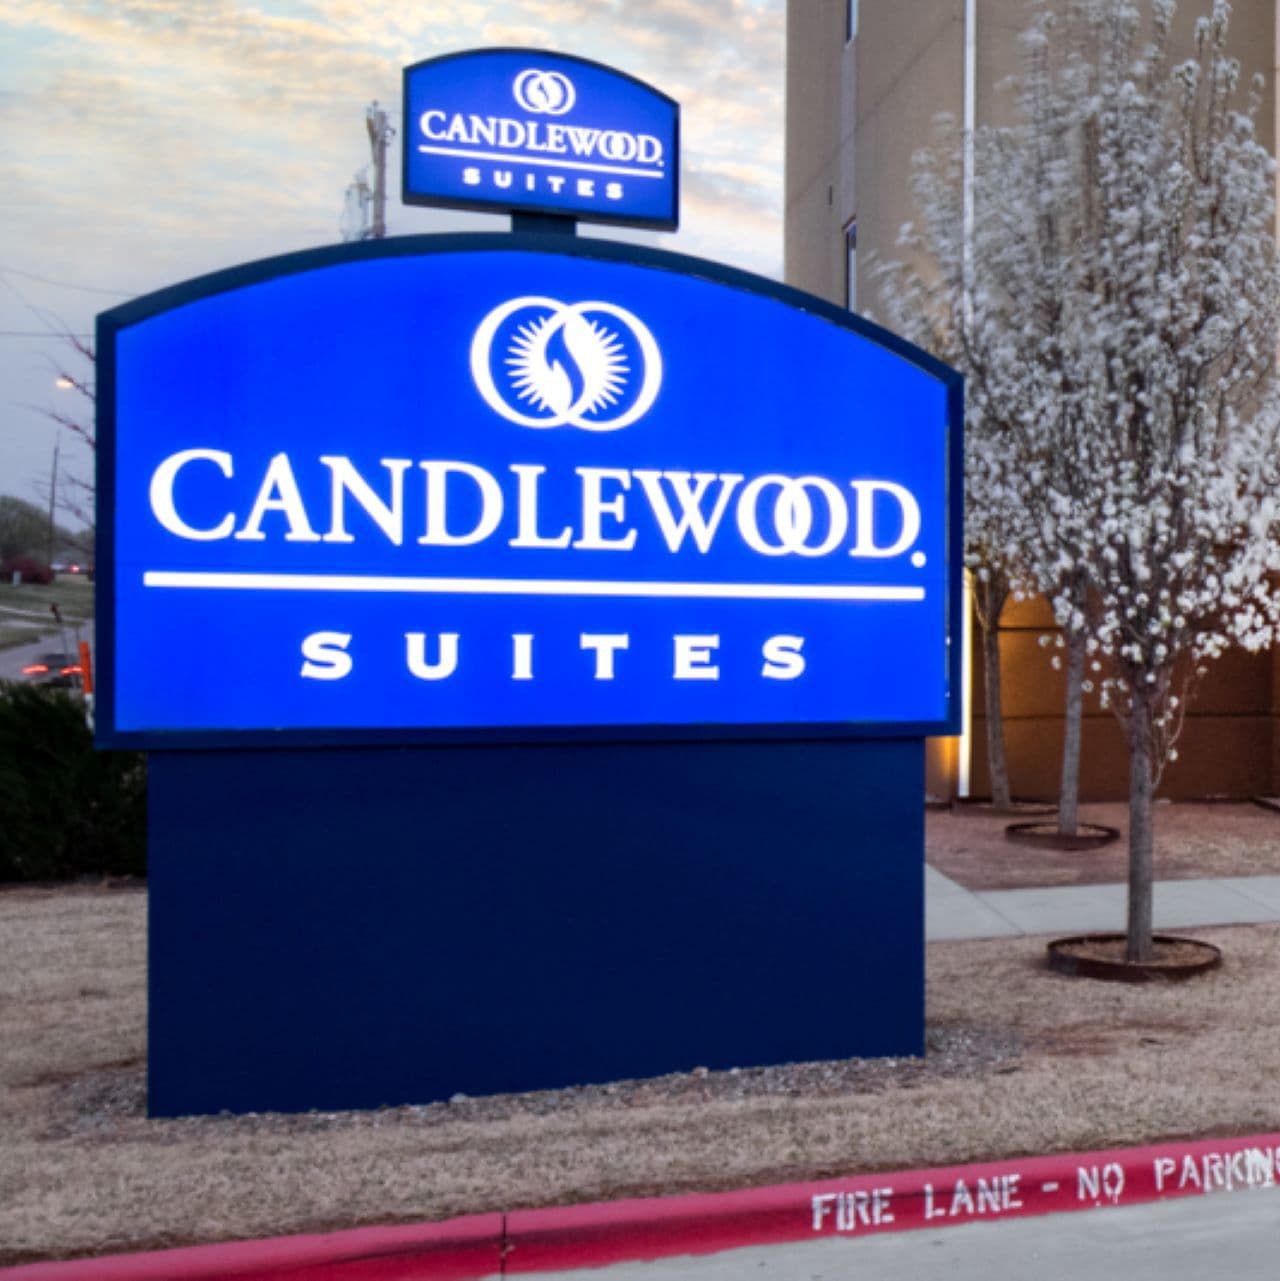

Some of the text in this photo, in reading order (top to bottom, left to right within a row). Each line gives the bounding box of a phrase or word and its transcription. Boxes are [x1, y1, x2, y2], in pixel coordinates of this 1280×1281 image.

[462, 167, 625, 200] SUITES
[300, 632, 807, 681] SUITES
[811, 1187, 895, 1231] FIRE
[924, 1173, 1024, 1220] LANE
[1077, 1162, 1126, 1202] NO
